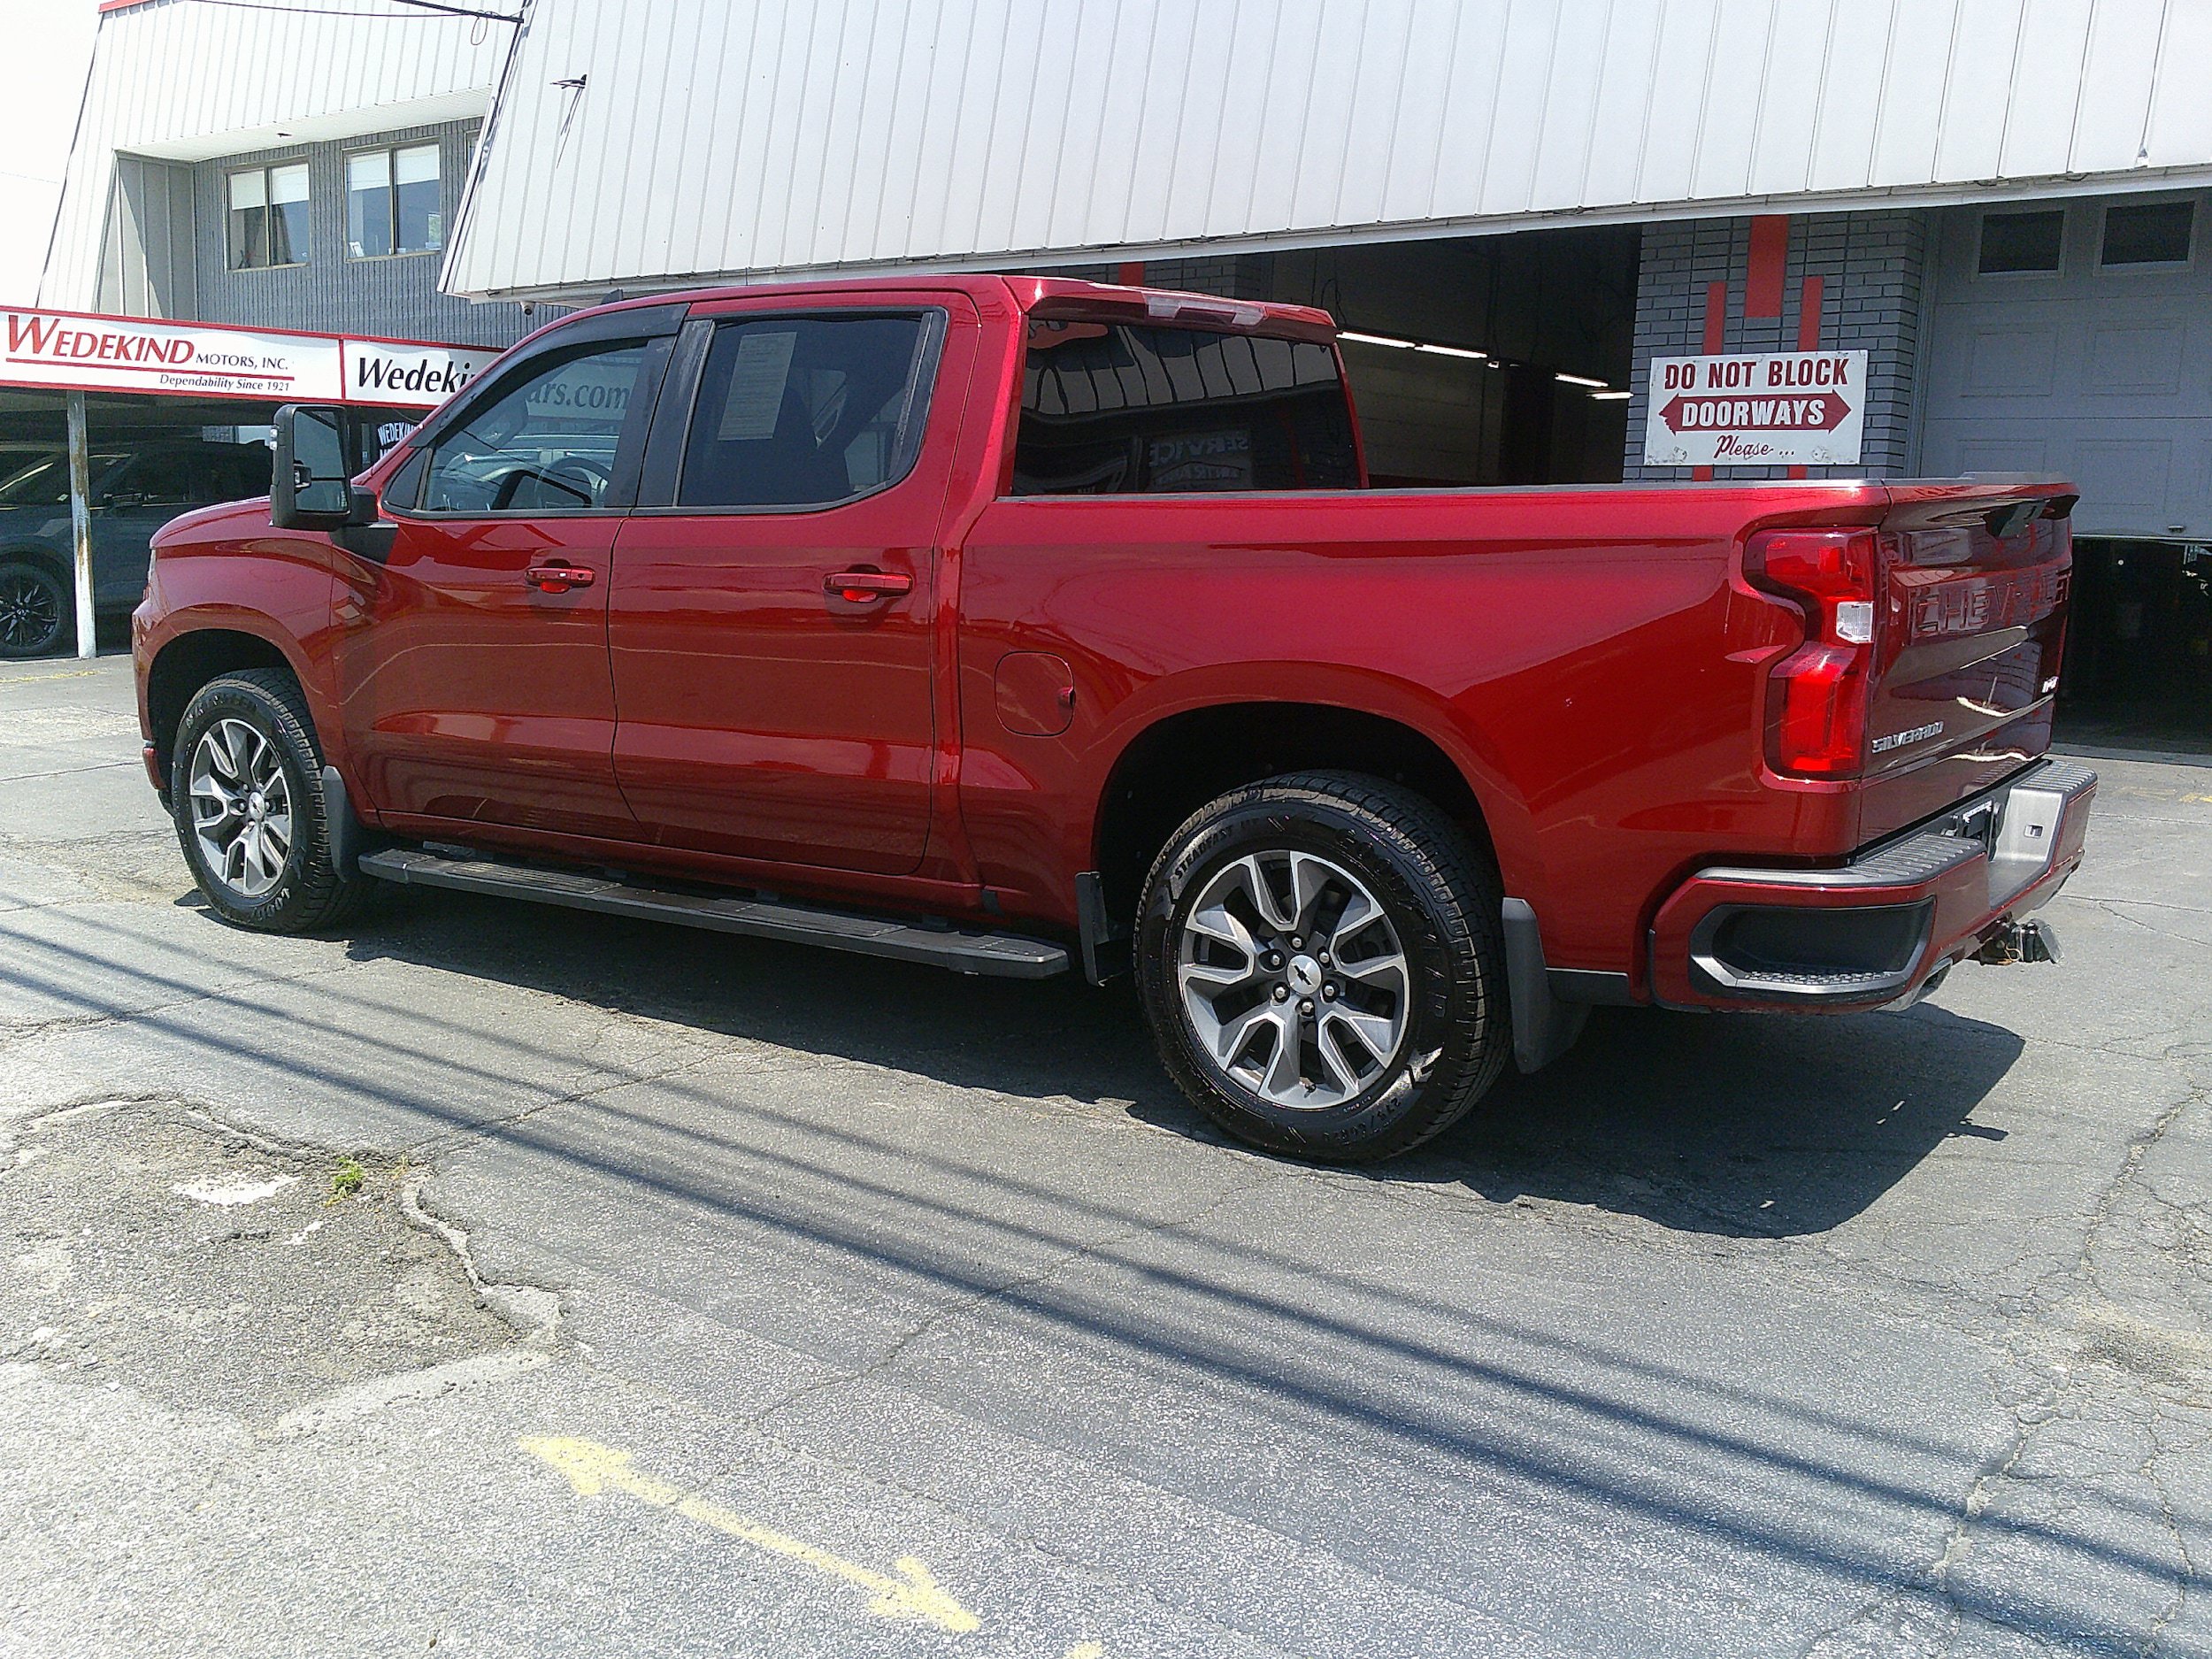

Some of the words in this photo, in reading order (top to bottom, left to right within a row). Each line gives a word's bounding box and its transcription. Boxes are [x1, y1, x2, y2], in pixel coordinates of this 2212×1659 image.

[8, 314, 195, 364] WEDEKIND
[196, 353, 257, 370] MOTORS,
[262, 357, 288, 370] INC.
[159, 373, 234, 391] Dependability
[236, 378, 264, 390] Since
[267, 380, 290, 391] 1921
[358, 357, 476, 393] Wedeki
[1664, 363, 1696, 390] DO
[1708, 361, 1756, 388] NOT
[1767, 358, 1849, 387] BLOCK
[1681, 399, 1825, 427] DOORWAYS
[378, 421, 416, 446] WEDEKI
[1713, 434, 1774, 458] Please
[1871, 721, 1945, 754] SILVERADO
